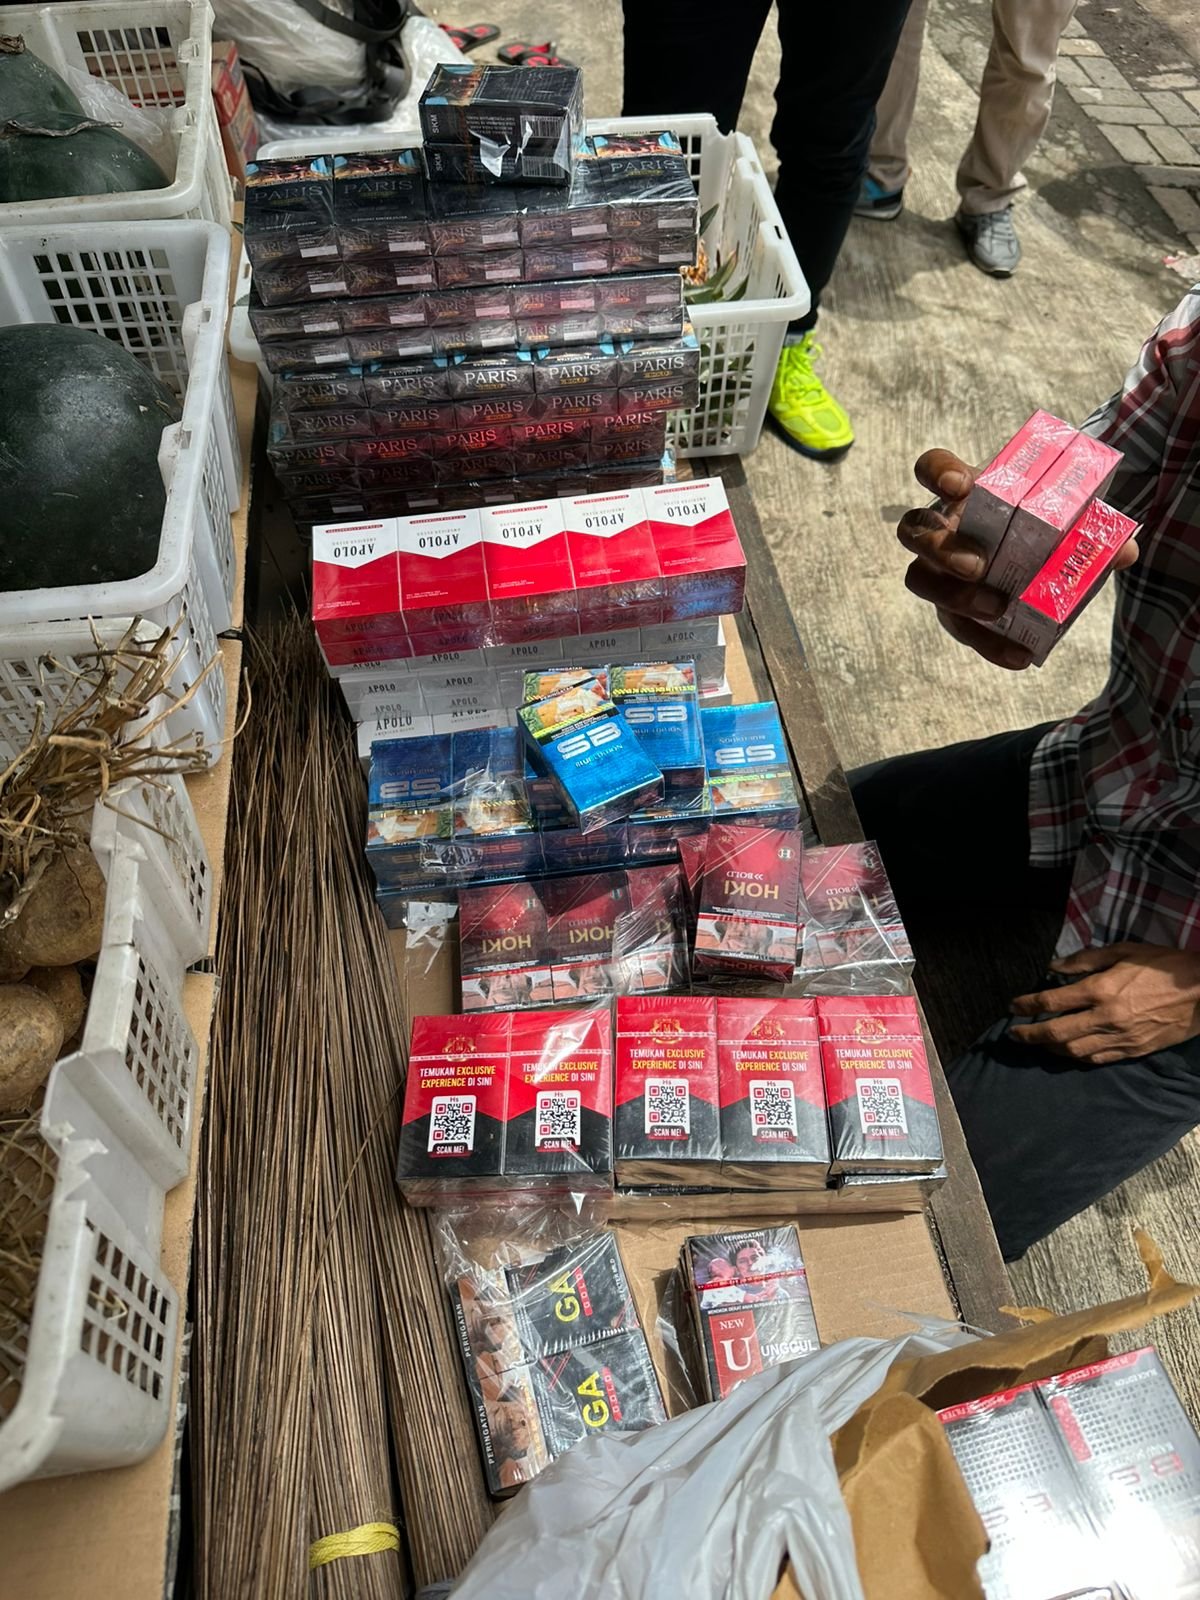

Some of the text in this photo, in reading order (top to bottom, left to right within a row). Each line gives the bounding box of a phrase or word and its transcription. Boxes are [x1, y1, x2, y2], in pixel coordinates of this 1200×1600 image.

[431, 114, 441, 133] SKM
[435, 153, 443, 172] SKM
[611, 159, 679, 174] PARIS
[254, 185, 324, 202] PARIS
[343, 179, 414, 196] PARIS
[549, 363, 601, 379] PARIS
[633, 355, 685, 373] PARIS
[380, 376, 435, 394] PARIS
[464, 369, 518, 385] PARIS
[295, 383, 349, 397] PARIS
[633, 385, 685, 403] PARIS
[472, 400, 524, 417] PARIS
[552, 394, 603, 410] PARIS
[303, 413, 357, 427] PARIS
[386, 408, 440, 423] PARIS
[604, 411, 653, 428] PARIS
[446, 429, 497, 445] PARIS
[525, 421, 575, 438] PARIS
[285, 445, 336, 461] PARIS
[367, 438, 418, 454] PARIS
[603, 439, 652, 455] PARIS
[667, 502, 707, 518] APOLO
[585, 513, 625, 528] APOLO
[502, 524, 542, 539] APOLO
[419, 533, 460, 549] APOLO
[334, 543, 375, 559] APOLO
[589, 638, 616, 648] APOLO
[667, 632, 695, 641] APOLO
[432, 652, 460, 662] APOLO
[511, 645, 538, 656] APOLO
[368, 683, 396, 693] APOLO
[446, 676, 473, 687] APOLO
[375, 703, 402, 714] APOLO
[451, 697, 478, 706] APOLO
[624, 705, 688, 723] SB
[556, 722, 622, 761] SB
[715, 744, 777, 765] SB
[380, 777, 441, 799] SB
[727, 870, 754, 880] BOLD
[724, 880, 779, 900] HOKI
[826, 887, 852, 896] BOLD
[569, 924, 616, 944] HOKI
[482, 934, 531, 954] HOKI
[630, 1049, 706, 1058] TEMUKAN EXCLUSIVE
[732, 1050, 810, 1060] TEMUKAN EXCLUSIVE
[835, 1049, 913, 1058] TEMUKAN EXCLUSIVE
[420, 1065, 497, 1077] TEMUKAN EXCLUSIVE
[559, 1061, 599, 1071] EXCLUSIVE
[632, 1060, 703, 1069] EXPERIENCE DI SINI
[735, 1062, 807, 1072] EXPERIENCE DI SINI
[840, 1060, 913, 1070] EXPERIENCE DI SINI
[421, 1077, 493, 1089] EXPERIENCE DI SINI
[571, 1073, 579, 1082] DI
[580, 1073, 596, 1082] SINI
[653, 1128, 682, 1137] SCAN ME!
[760, 1129, 791, 1139] SCAN ME!
[871, 1127, 901, 1137] SCAN ME!
[436, 1145, 465, 1155] SCAN ME!
[543, 1140, 559, 1149] SCAN
[723, 1231, 765, 1242] PERINGATAN
[547, 1270, 581, 1322] GA
[576, 1272, 592, 1311] GOLD
[456, 1303, 471, 1357] PERINGATAN
[719, 1318, 745, 1330] NEW
[720, 1336, 752, 1372] U
[761, 1340, 818, 1357] UNGGUL
[1115, 1370, 1158, 1387] BLACK EDITION
[577, 1370, 610, 1428] GA
[605, 1373, 621, 1414] GOLD
[942, 1410, 962, 1421] FILTER
[478, 1404, 495, 1465] PERINGATAN
